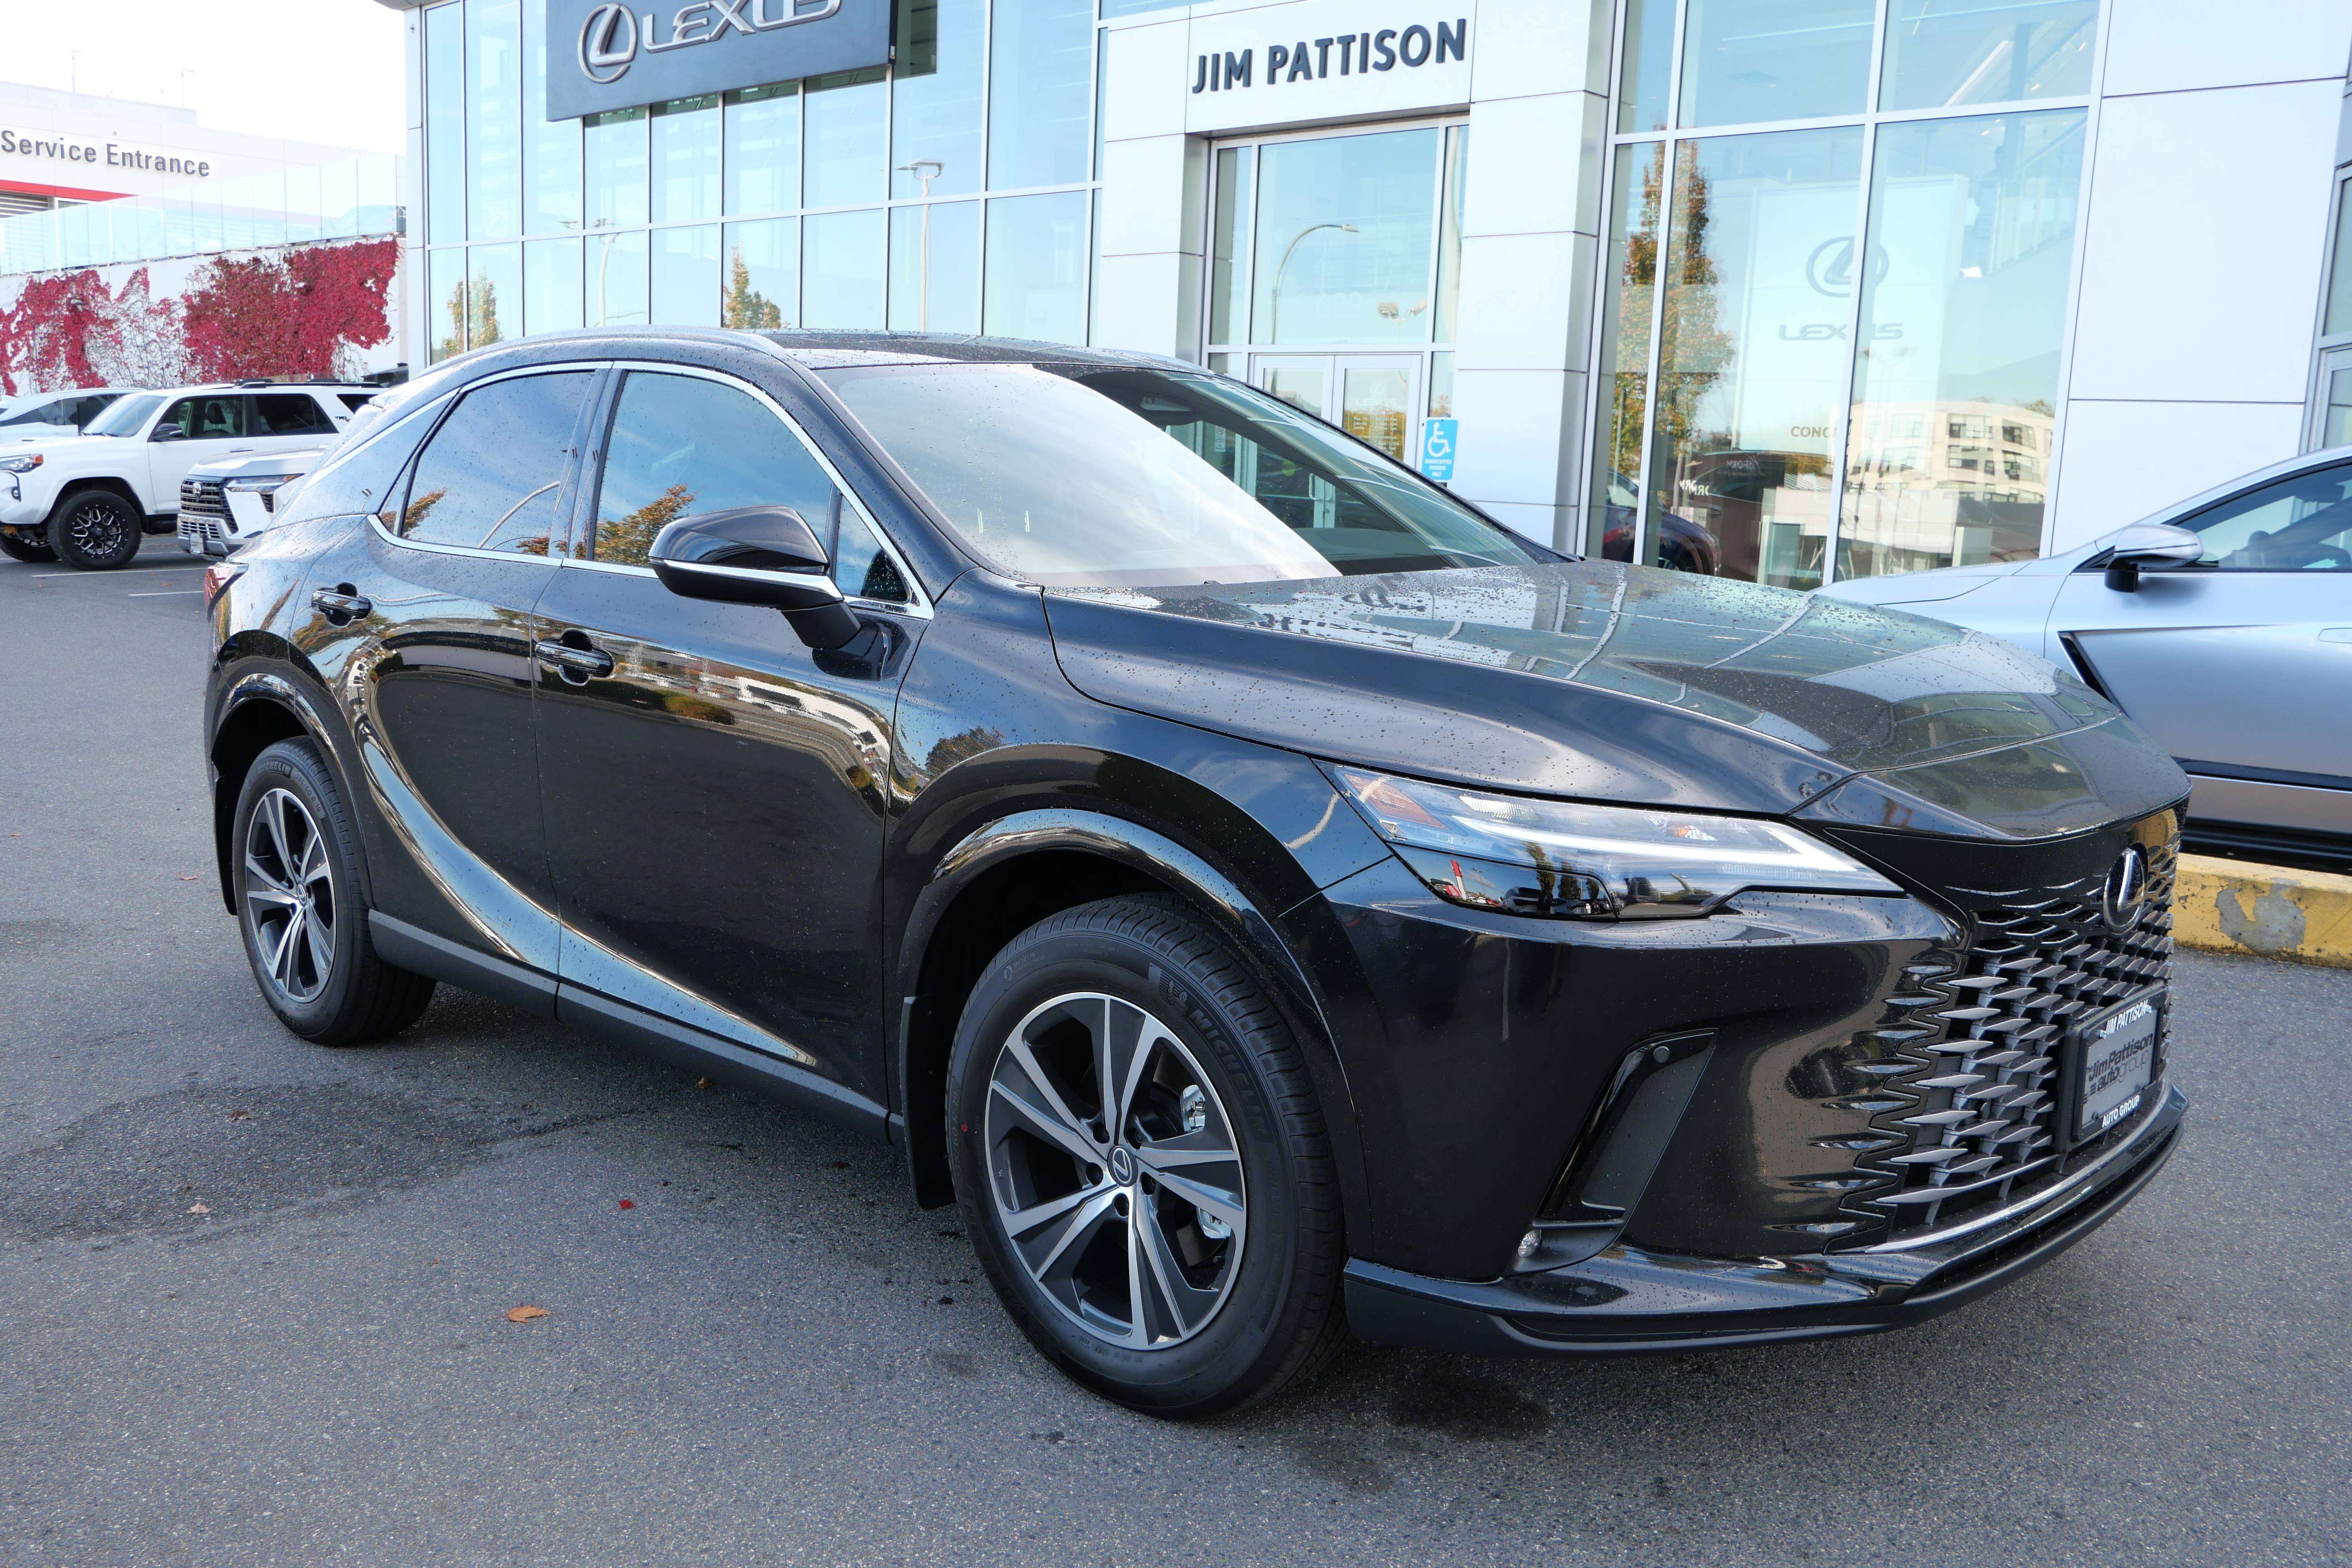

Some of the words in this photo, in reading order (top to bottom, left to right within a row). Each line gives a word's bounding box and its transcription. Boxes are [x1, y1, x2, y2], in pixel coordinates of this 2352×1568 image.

[1192, 49, 1252, 94] JIM
[1267, 18, 1467, 85] PATTISON
[1, 129, 97, 162] Service
[106, 143, 211, 177] Entrance
[1779, 323, 1903, 340] LEXS
[258, 761, 291, 775] MICHELIN
[2106, 1016, 2117, 1036] JIM
[2116, 999, 2149, 1030] PATTISON
[1189, 1008, 1269, 1136] MICHELIN
[2088, 1058, 2108, 1082] Jim
[2107, 1033, 2153, 1069] Pattison
[2102, 1108, 2118, 1128] AUTO
[2119, 1094, 2140, 1117] GROUP
